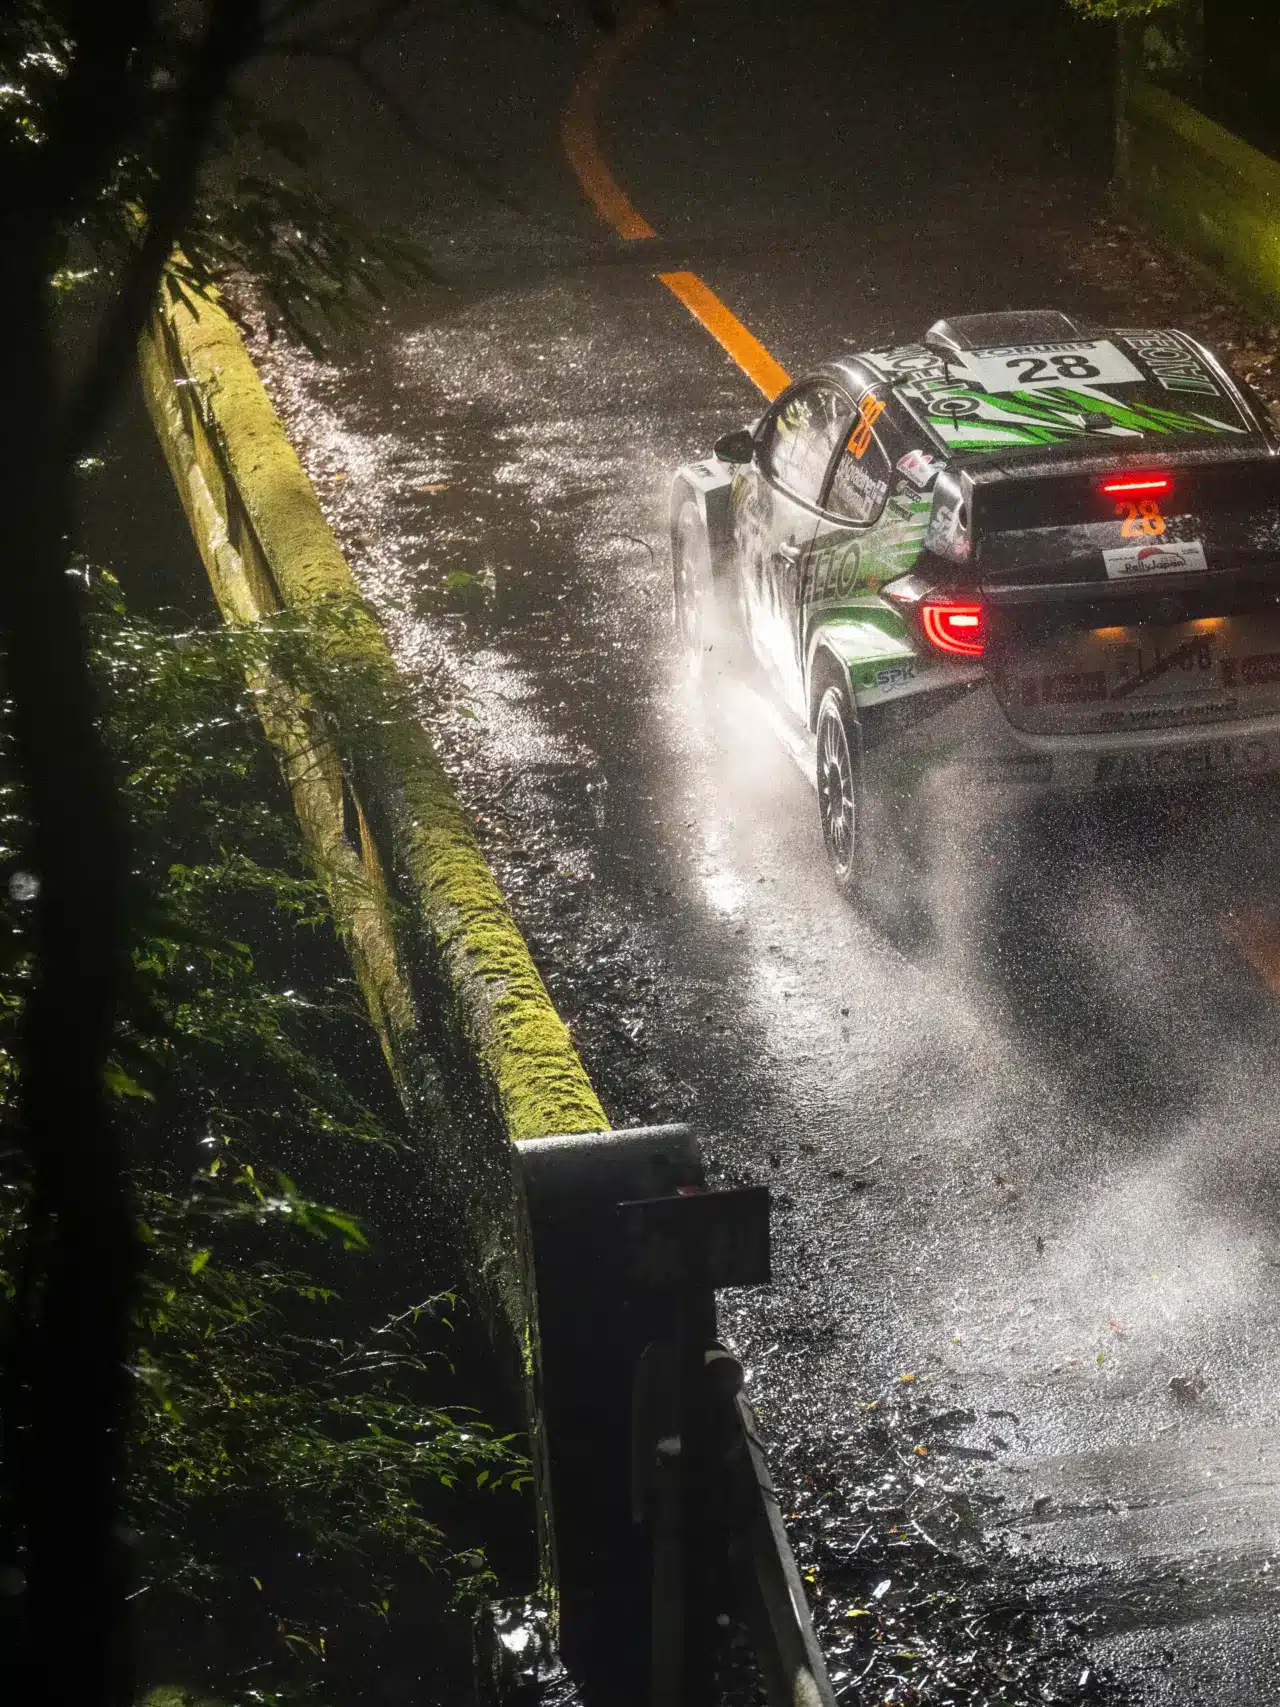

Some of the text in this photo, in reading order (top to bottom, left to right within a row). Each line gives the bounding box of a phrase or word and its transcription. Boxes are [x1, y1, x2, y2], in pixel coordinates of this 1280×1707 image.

[1006, 355, 1101, 383] 28
[847, 394, 886, 459] 28
[1116, 500, 1167, 537] 28
[790, 542, 862, 605] ELLO
[876, 666, 916, 687] SPK
